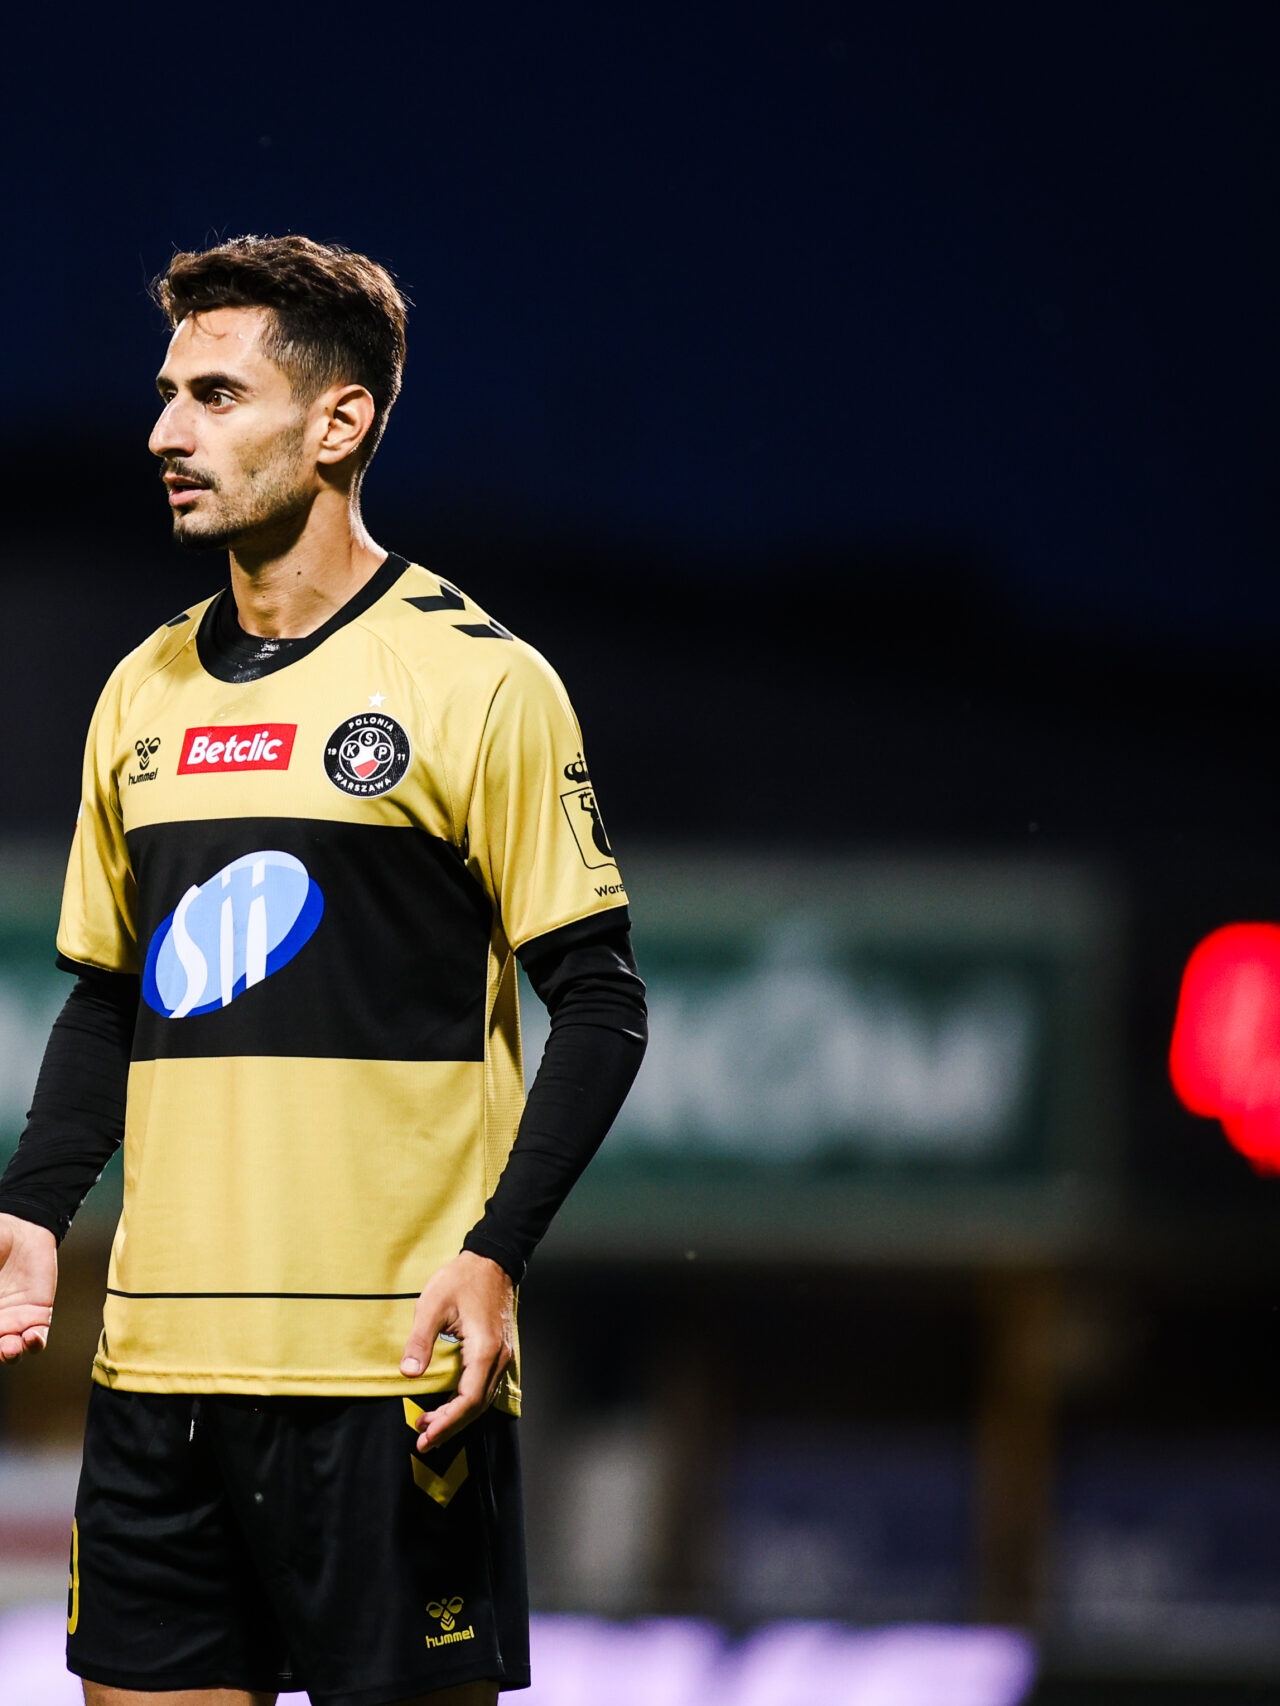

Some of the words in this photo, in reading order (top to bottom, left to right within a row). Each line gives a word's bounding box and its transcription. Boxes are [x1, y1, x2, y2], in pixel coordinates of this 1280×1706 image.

[348, 716, 394, 732] POLONIA
[186, 730, 283, 765] Betclic
[327, 748, 337, 756] 19
[397, 753, 406, 761] 11
[128, 768, 158, 786] hummel
[334, 772, 392, 792] WARSZAWA
[425, 1625, 475, 1649] hummel
